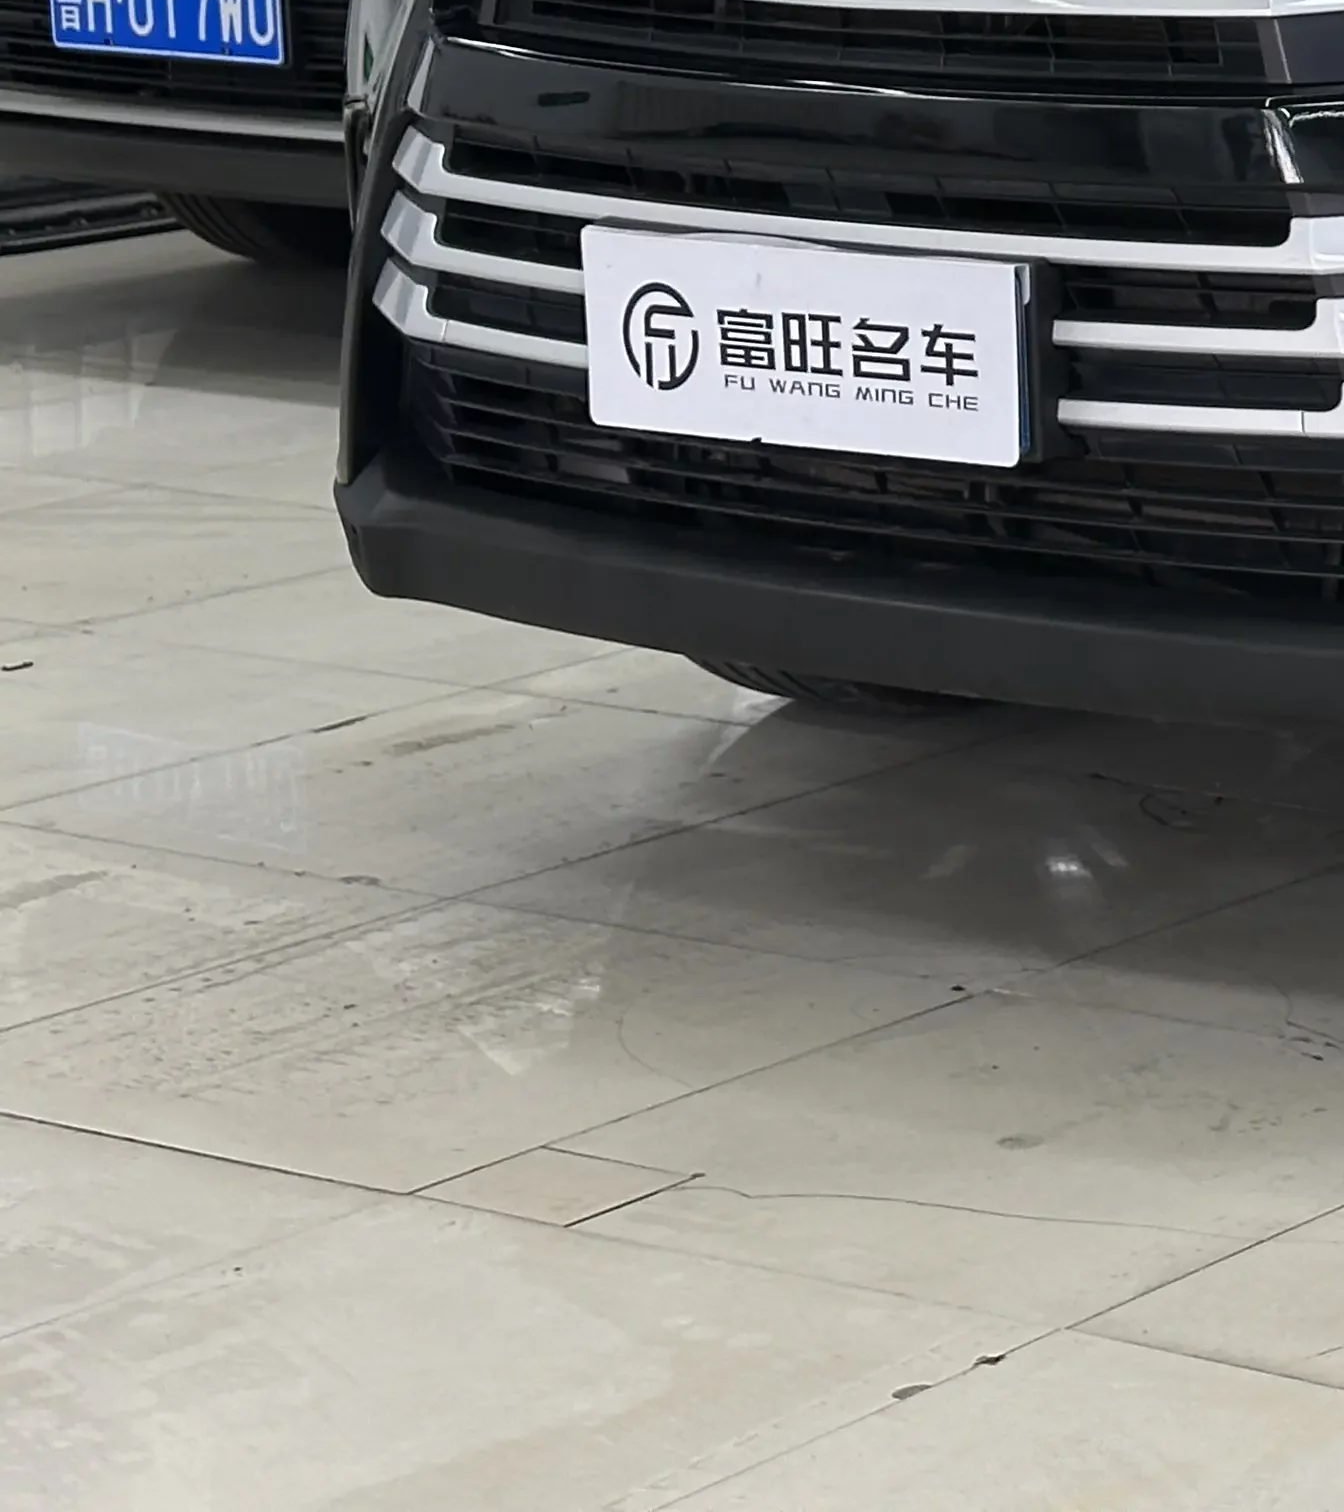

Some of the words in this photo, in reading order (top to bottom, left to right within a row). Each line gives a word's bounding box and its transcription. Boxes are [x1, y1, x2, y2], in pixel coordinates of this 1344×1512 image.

[716, 308, 979, 386] 富旺名车
[724, 374, 756, 391] FU
[769, 378, 841, 399] WANG
[855, 387, 914, 405] MING
[929, 393, 979, 411] CHE
